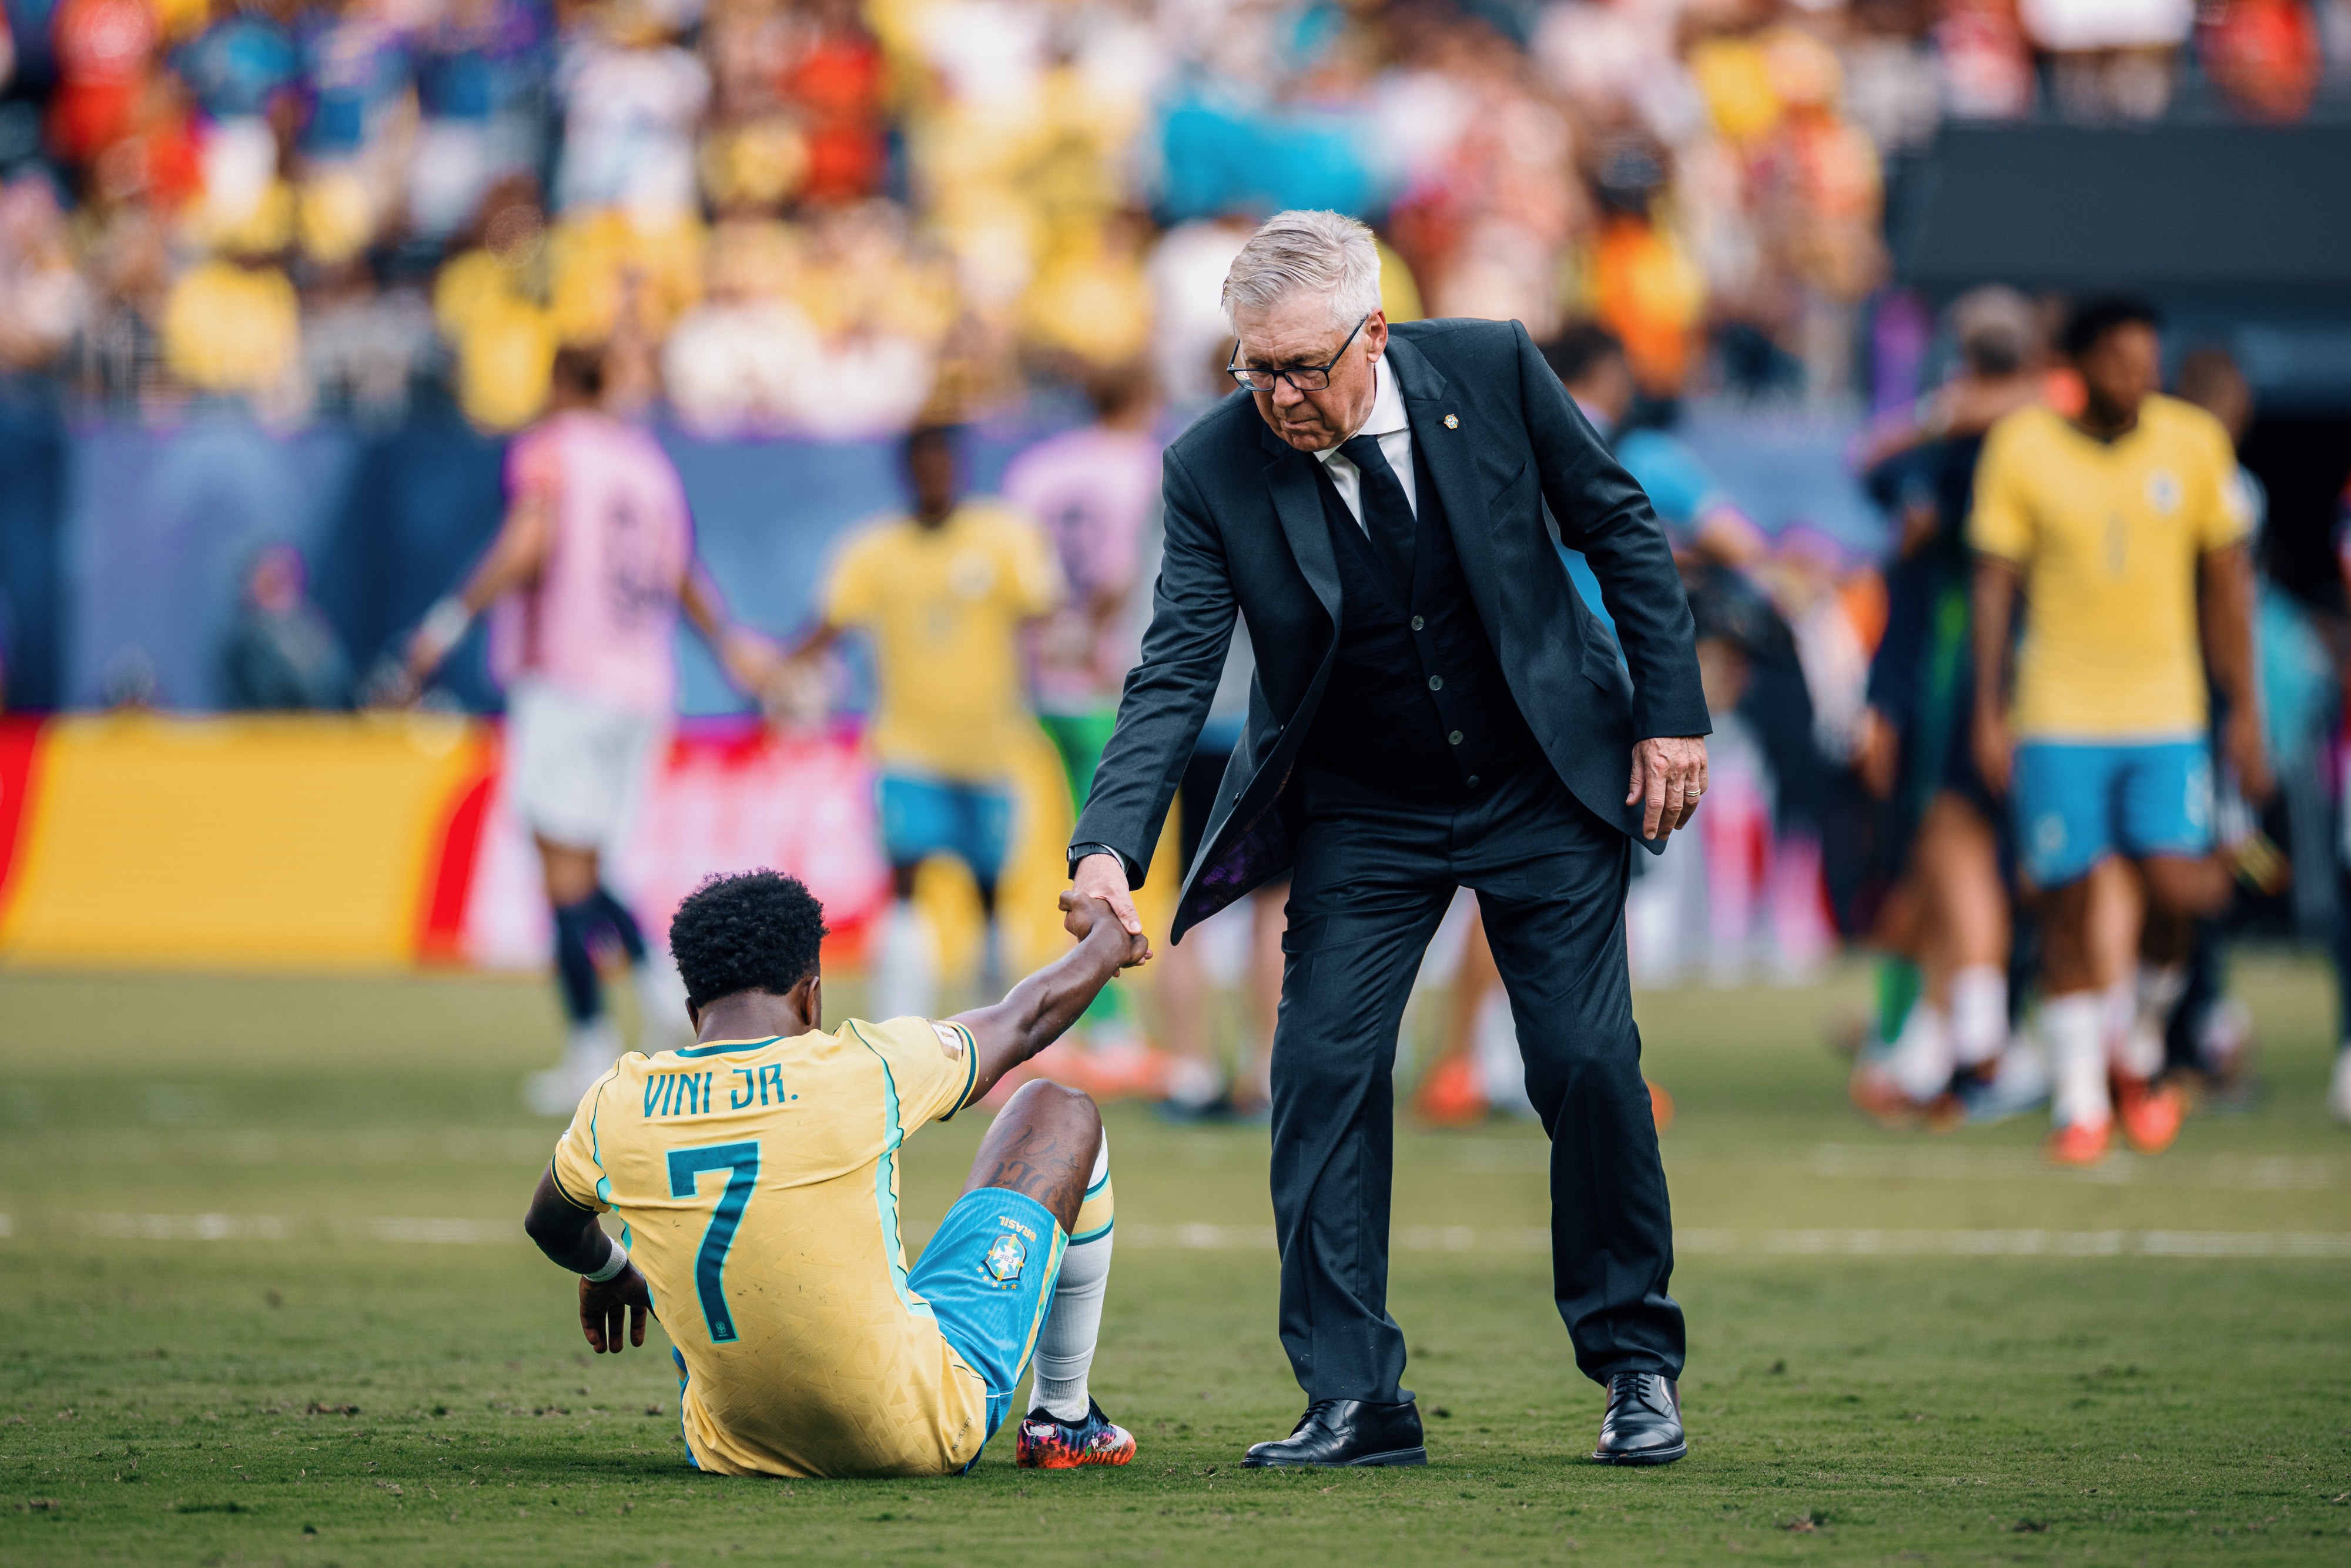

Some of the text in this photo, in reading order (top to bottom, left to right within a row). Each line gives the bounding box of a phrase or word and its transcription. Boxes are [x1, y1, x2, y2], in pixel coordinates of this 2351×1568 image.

[644, 1063, 798, 1118] VINI JR.
[664, 1138, 761, 1344] 7
[999, 1215, 1037, 1242] BRASIL
[999, 1254, 1014, 1264] CBF
